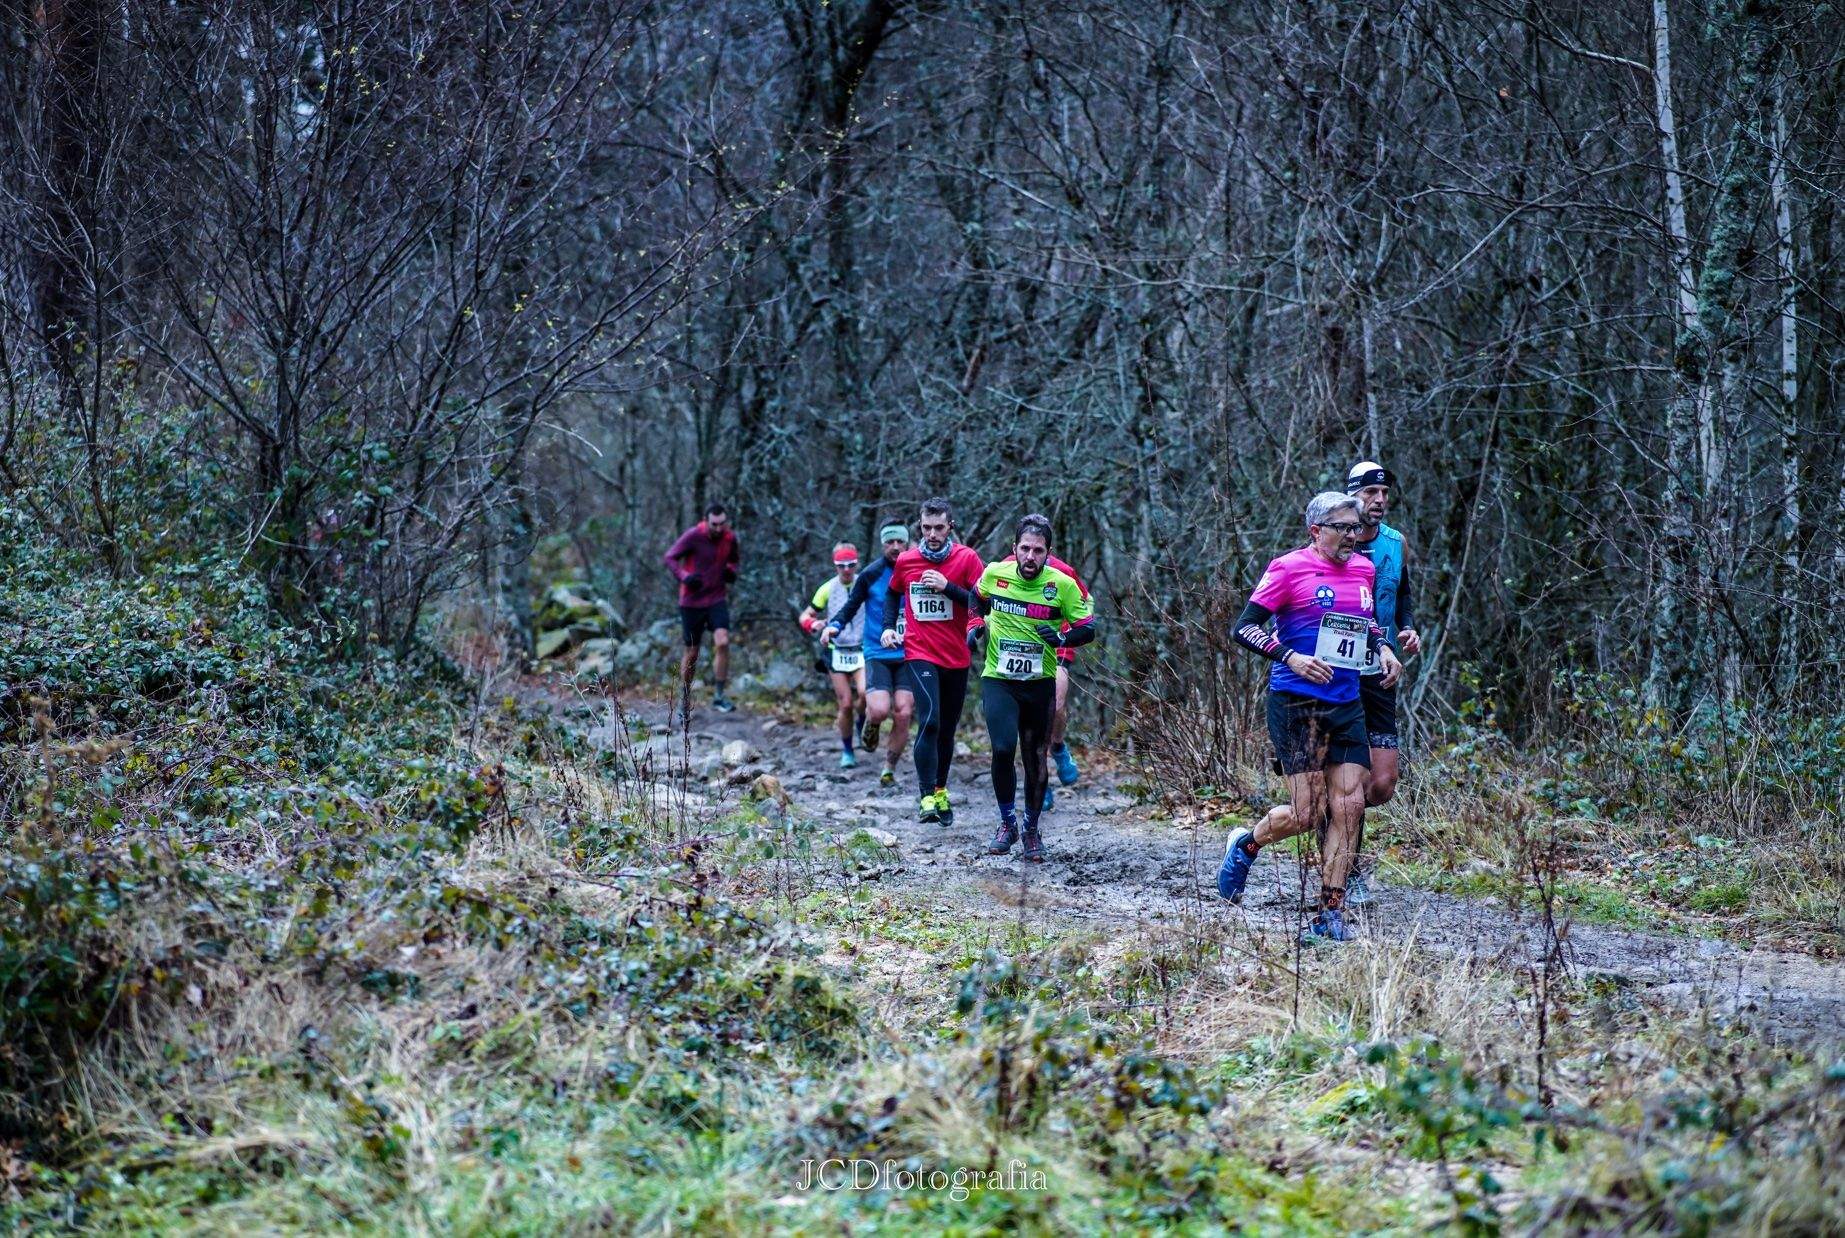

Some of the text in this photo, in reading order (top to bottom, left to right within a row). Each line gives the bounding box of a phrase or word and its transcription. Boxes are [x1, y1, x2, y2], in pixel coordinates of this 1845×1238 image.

[917, 600, 945, 613] 1164
[1337, 639, 1355, 658] 41
[1006, 658, 1032, 673] 420
